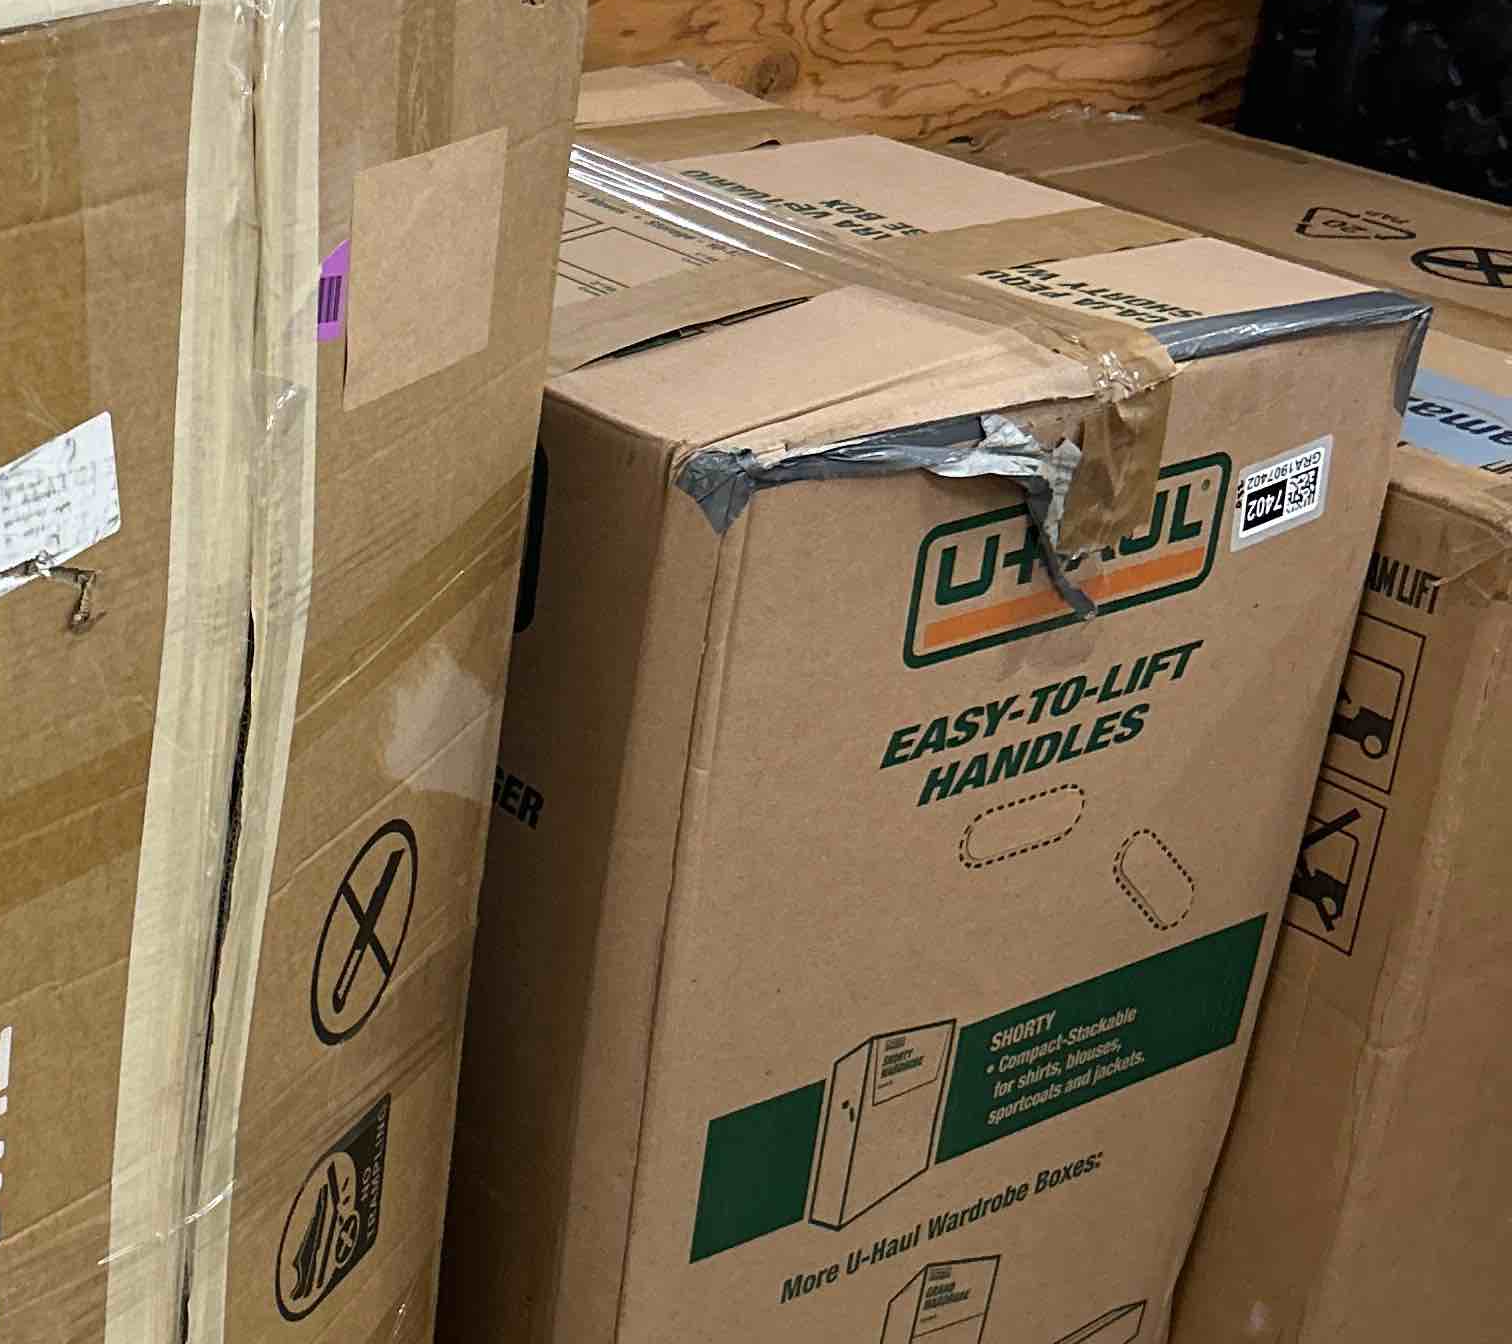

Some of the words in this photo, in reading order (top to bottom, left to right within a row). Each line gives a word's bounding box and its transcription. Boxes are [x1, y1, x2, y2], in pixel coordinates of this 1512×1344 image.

[1058, 282, 1204, 320] SHORTY
[1072, 298, 1170, 325] CAJA
[1246, 451, 1322, 491] GRA1907402
[1246, 488, 1284, 522] 7402
[1397, 564, 1442, 615] LIFT
[879, 639, 1205, 770] EASY-TO-LIFT
[917, 703, 1151, 807] HANDLES
[989, 1009, 1057, 1052] SHORTY
[987, 1083, 1063, 1125] sportcoats
[1063, 1068, 1093, 1094] and
[1091, 1050, 1145, 1088] jackets.
[992, 1079, 1016, 1099] for
[1017, 1061, 1063, 1089] shirts,
[1065, 1037, 1122, 1070] blouses,
[779, 1264, 839, 1304] More
[845, 1224, 922, 1276] U-Haul
[928, 1181, 1030, 1239] Wardrobe
[1034, 1151, 1104, 1194] Boxes:
